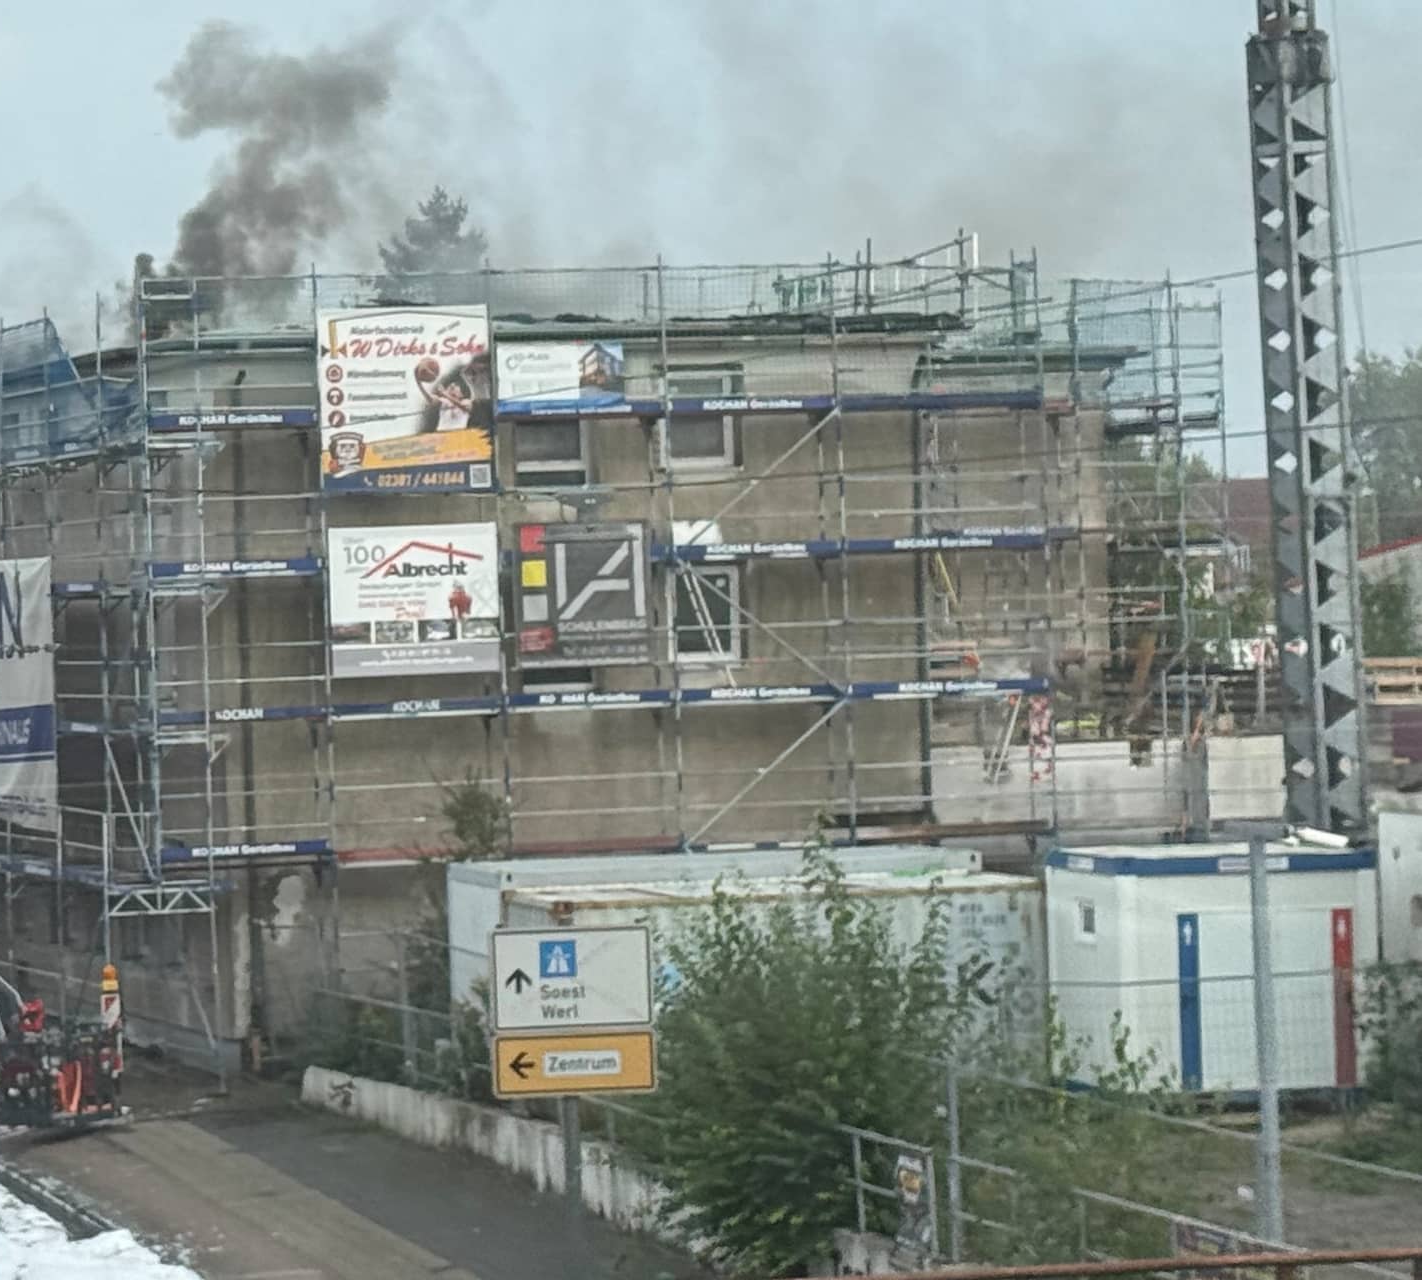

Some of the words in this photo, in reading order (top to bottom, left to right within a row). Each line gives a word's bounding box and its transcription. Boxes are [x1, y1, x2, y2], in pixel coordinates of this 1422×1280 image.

[375, 336, 426, 358] Dirks
[440, 334, 486, 357] Sohn
[179, 415, 226, 426] KOHAN
[344, 545, 386, 564] 100
[183, 562, 230, 573] KOHAN
[383, 556, 467, 578] Albrecht
[540, 983, 586, 1000] Soest
[541, 1003, 579, 1020] Werl
[548, 1055, 618, 1073] Zentrum
